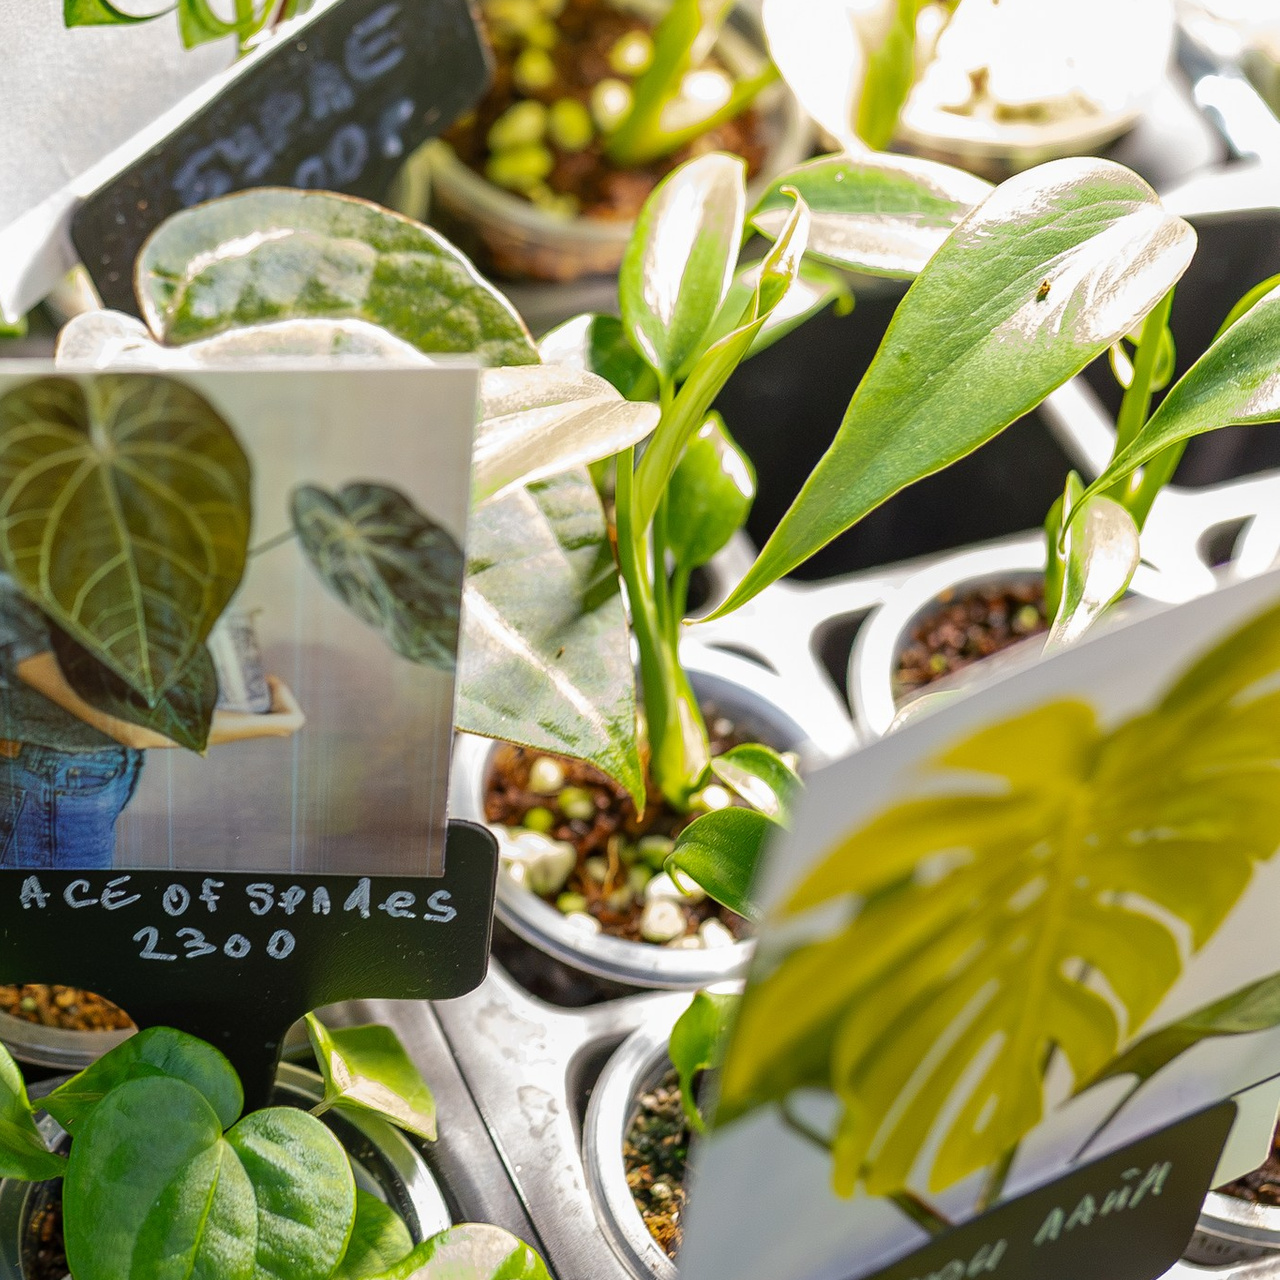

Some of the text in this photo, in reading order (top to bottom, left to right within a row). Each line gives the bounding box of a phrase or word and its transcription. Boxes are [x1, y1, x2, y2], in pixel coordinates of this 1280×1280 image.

[20, 874, 140, 910] ACE
[162, 878, 225, 916] OF
[133, 925, 297, 961] 2300
